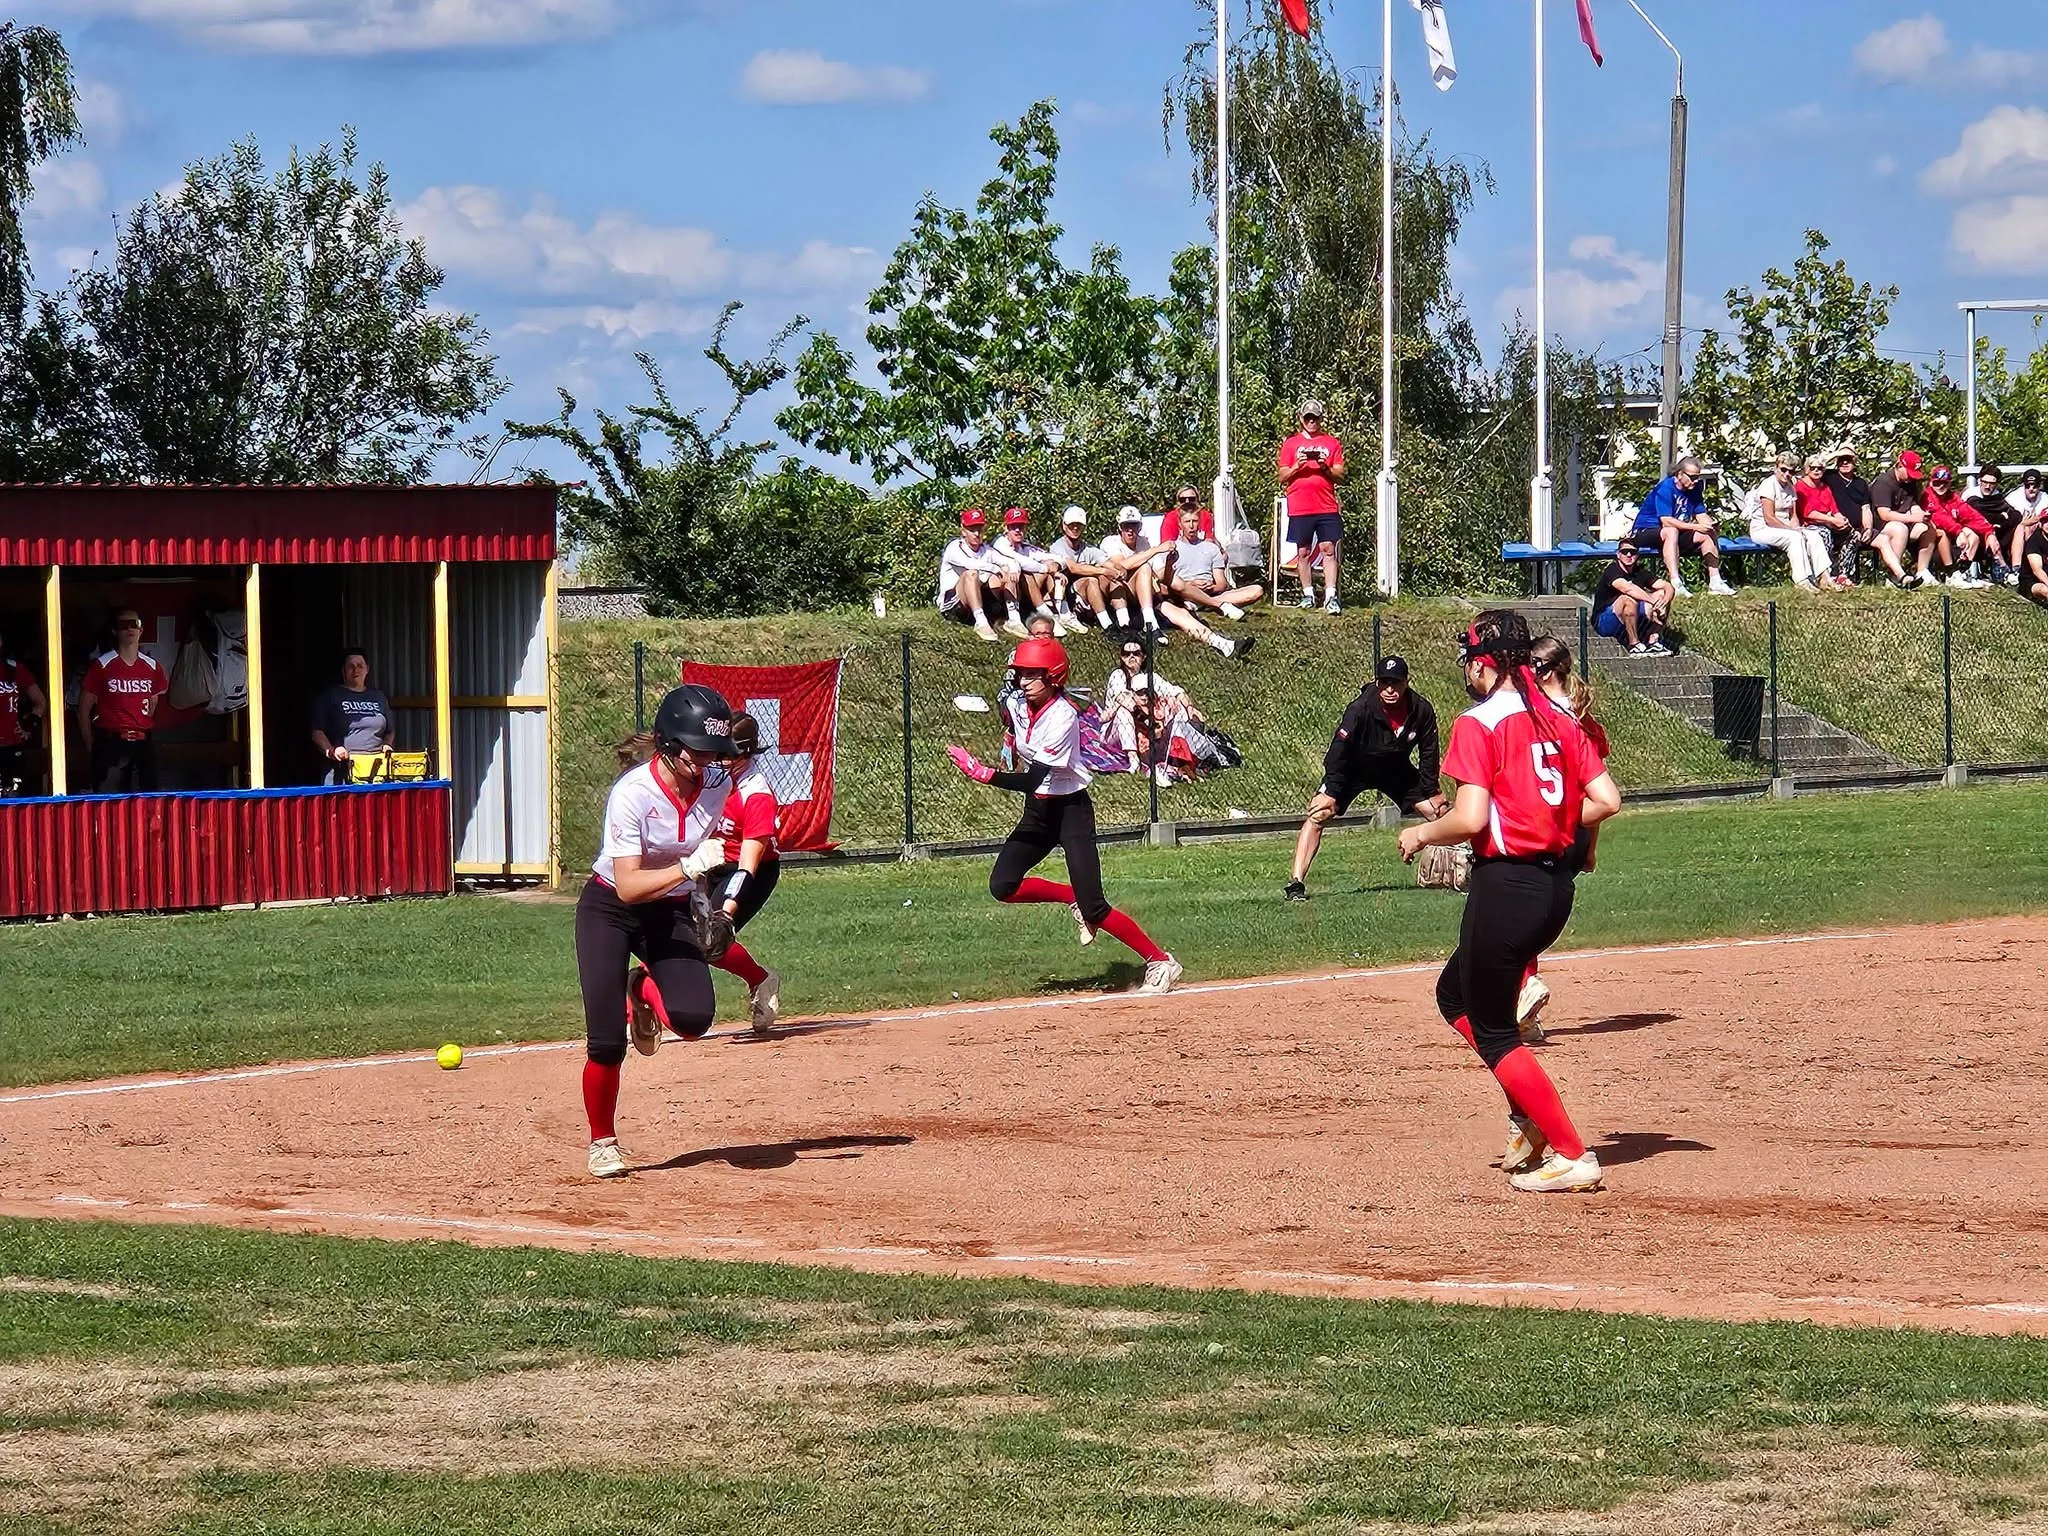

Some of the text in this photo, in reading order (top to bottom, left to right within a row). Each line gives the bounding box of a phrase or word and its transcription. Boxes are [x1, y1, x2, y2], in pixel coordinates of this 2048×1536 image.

[140, 698, 150, 716] 3
[341, 700, 382, 712] SUISSE
[1529, 740, 1565, 807] 5
